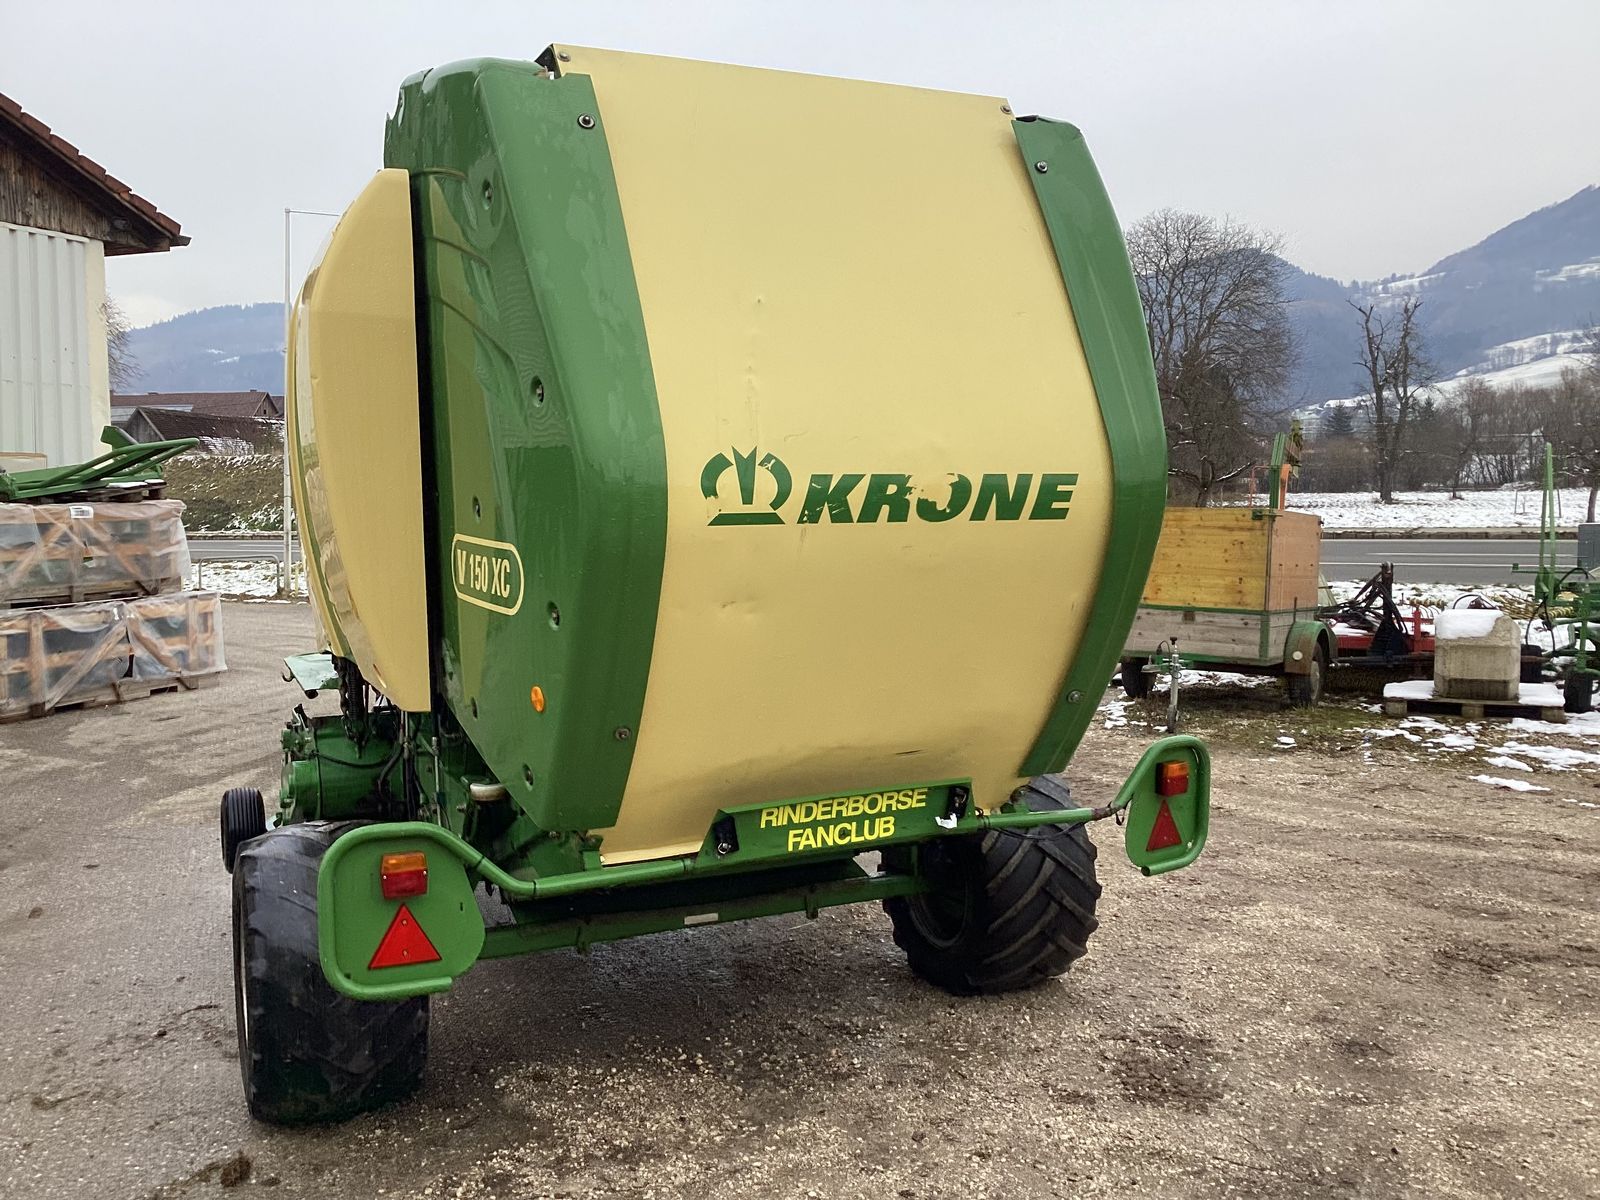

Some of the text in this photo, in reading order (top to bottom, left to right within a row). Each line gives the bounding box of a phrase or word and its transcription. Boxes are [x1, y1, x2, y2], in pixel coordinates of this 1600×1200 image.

[797, 473, 1079, 524] KRONE
[456, 549, 510, 598] V 150 XC
[760, 788, 928, 828] RINDERBORSE
[787, 816, 895, 852] FANCLUB
